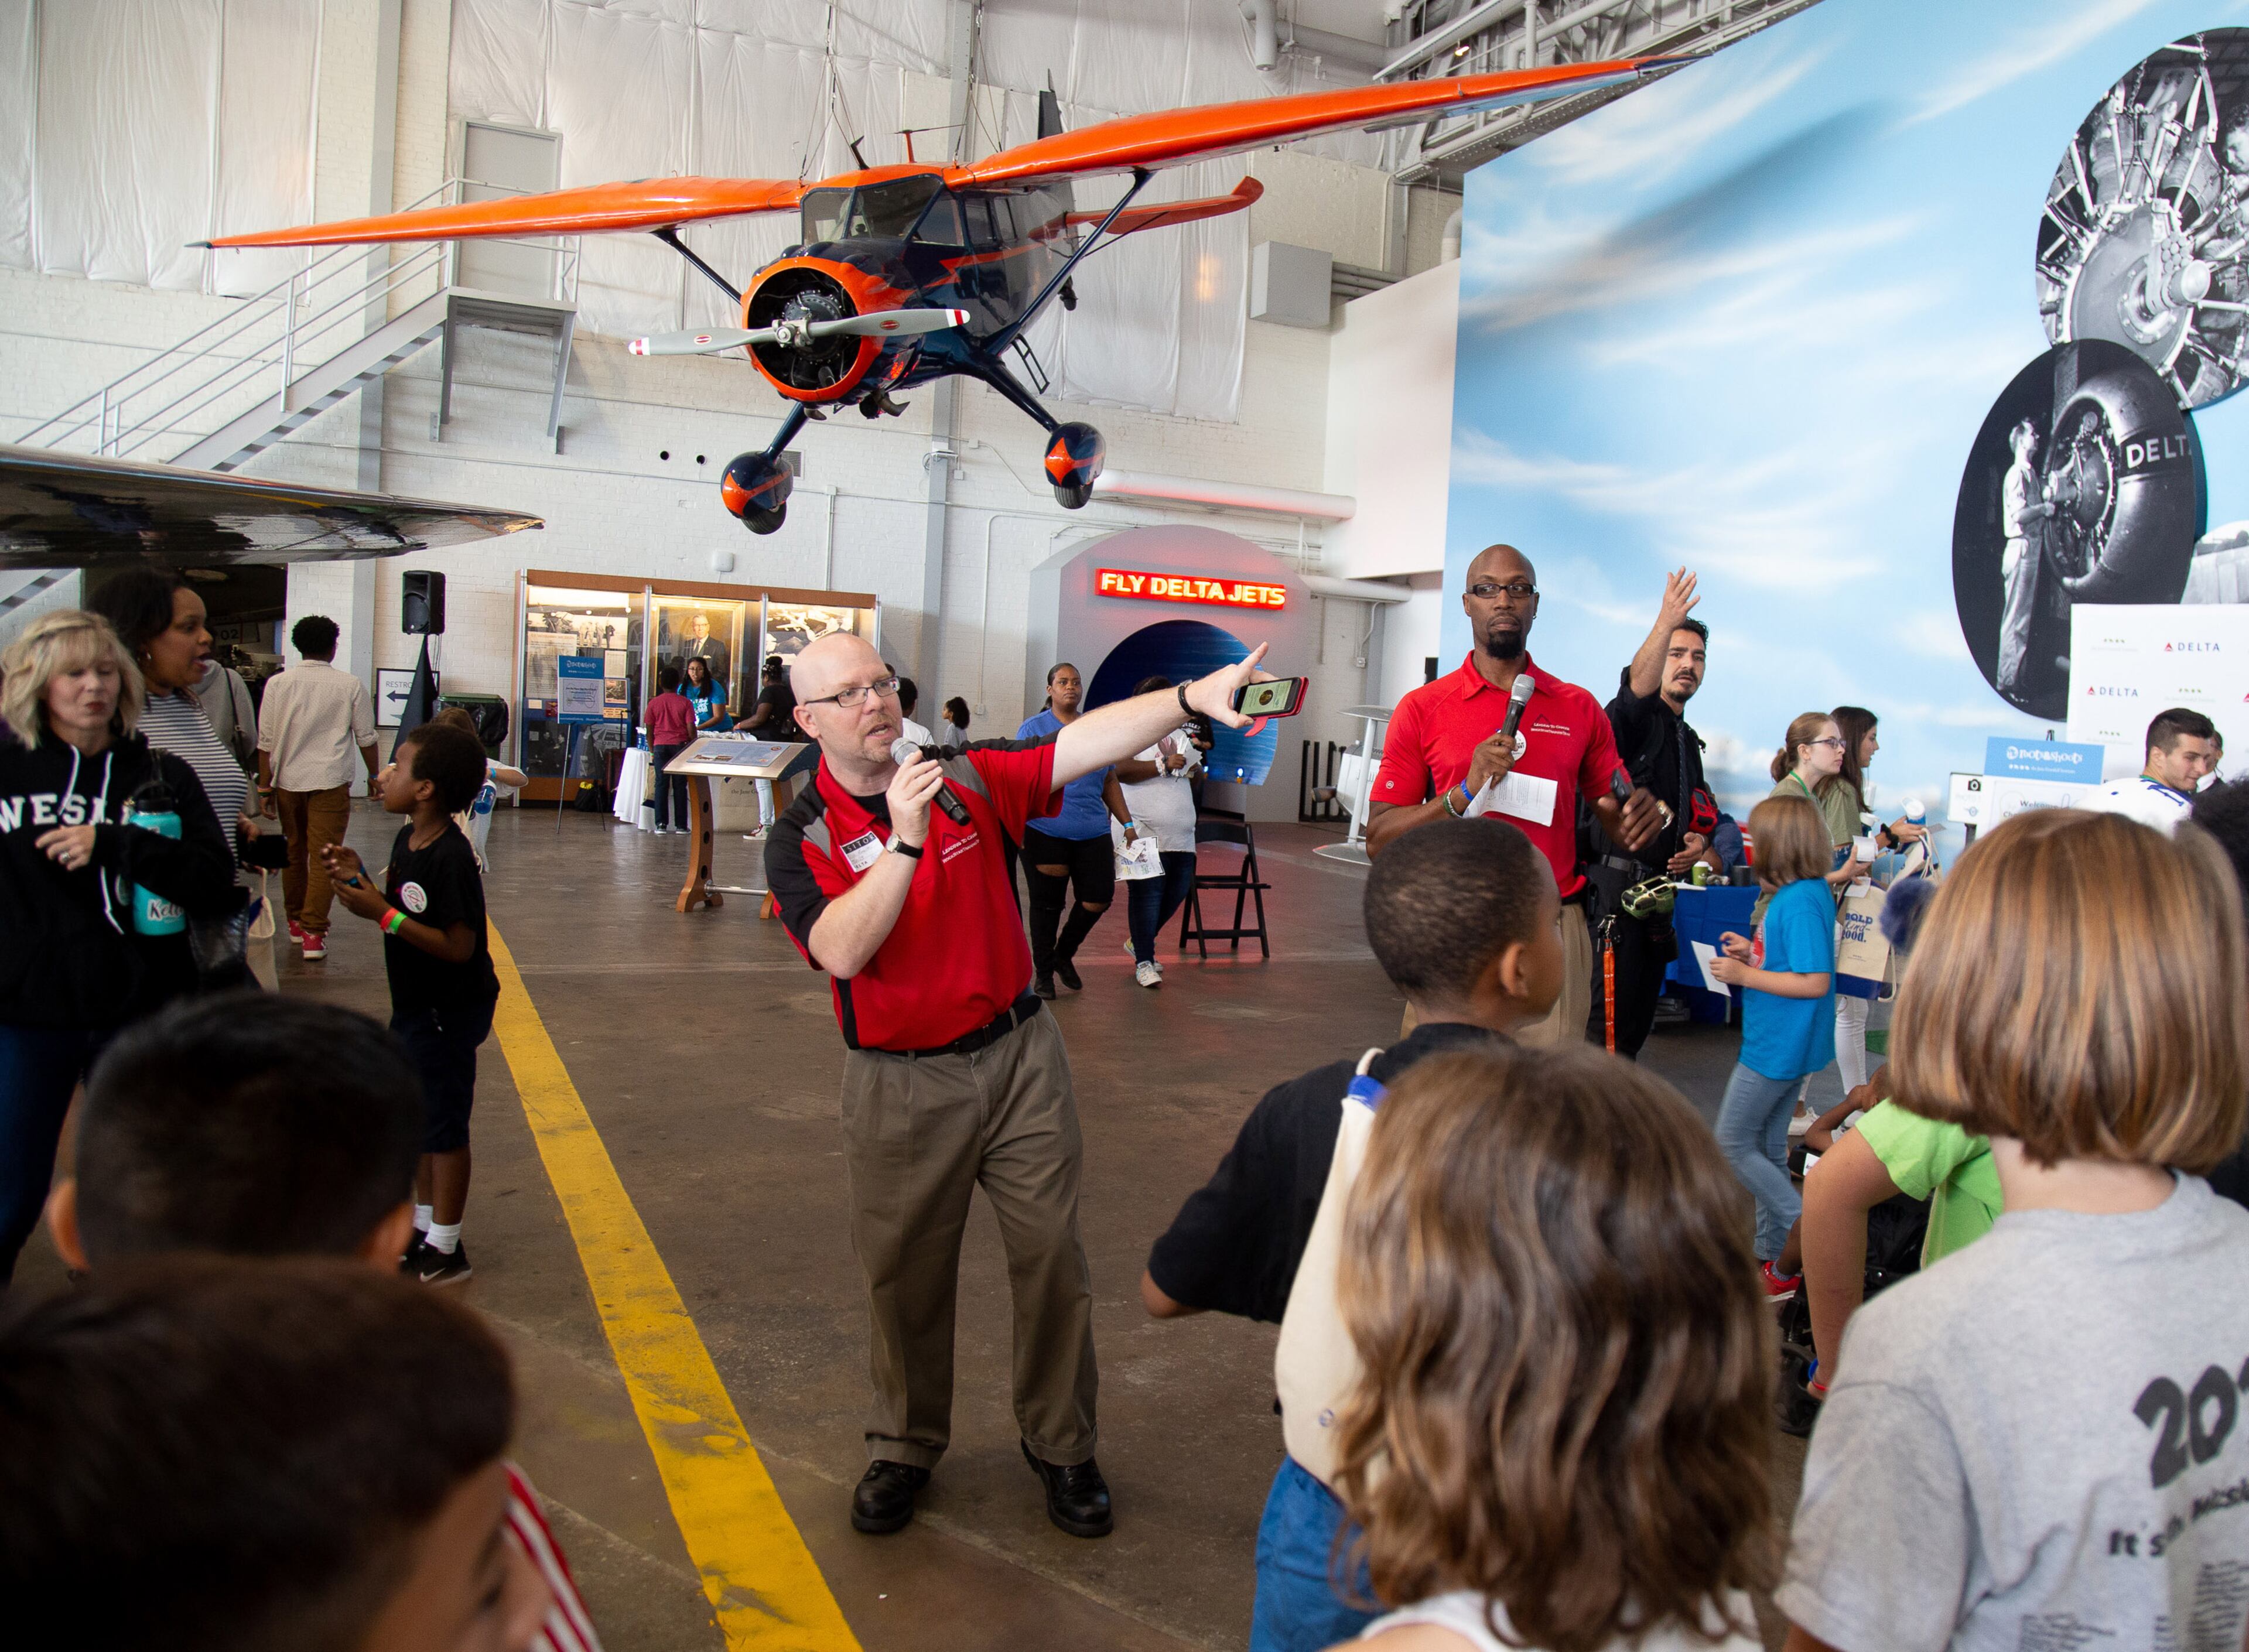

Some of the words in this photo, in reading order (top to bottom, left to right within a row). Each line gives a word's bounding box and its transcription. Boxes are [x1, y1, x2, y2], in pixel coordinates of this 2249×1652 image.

[2126, 434, 2192, 469] DELT
[1101, 572, 1146, 593] FLY
[1150, 576, 1226, 601] DELTA
[1227, 583, 1287, 605] JETS
[2178, 642, 2220, 652] DELTA
[2099, 686, 2138, 697] DELTA
[2020, 800, 2057, 809] Welcome
[844, 833, 875, 853] SITOR
[2132, 1363, 2249, 1490] 20
